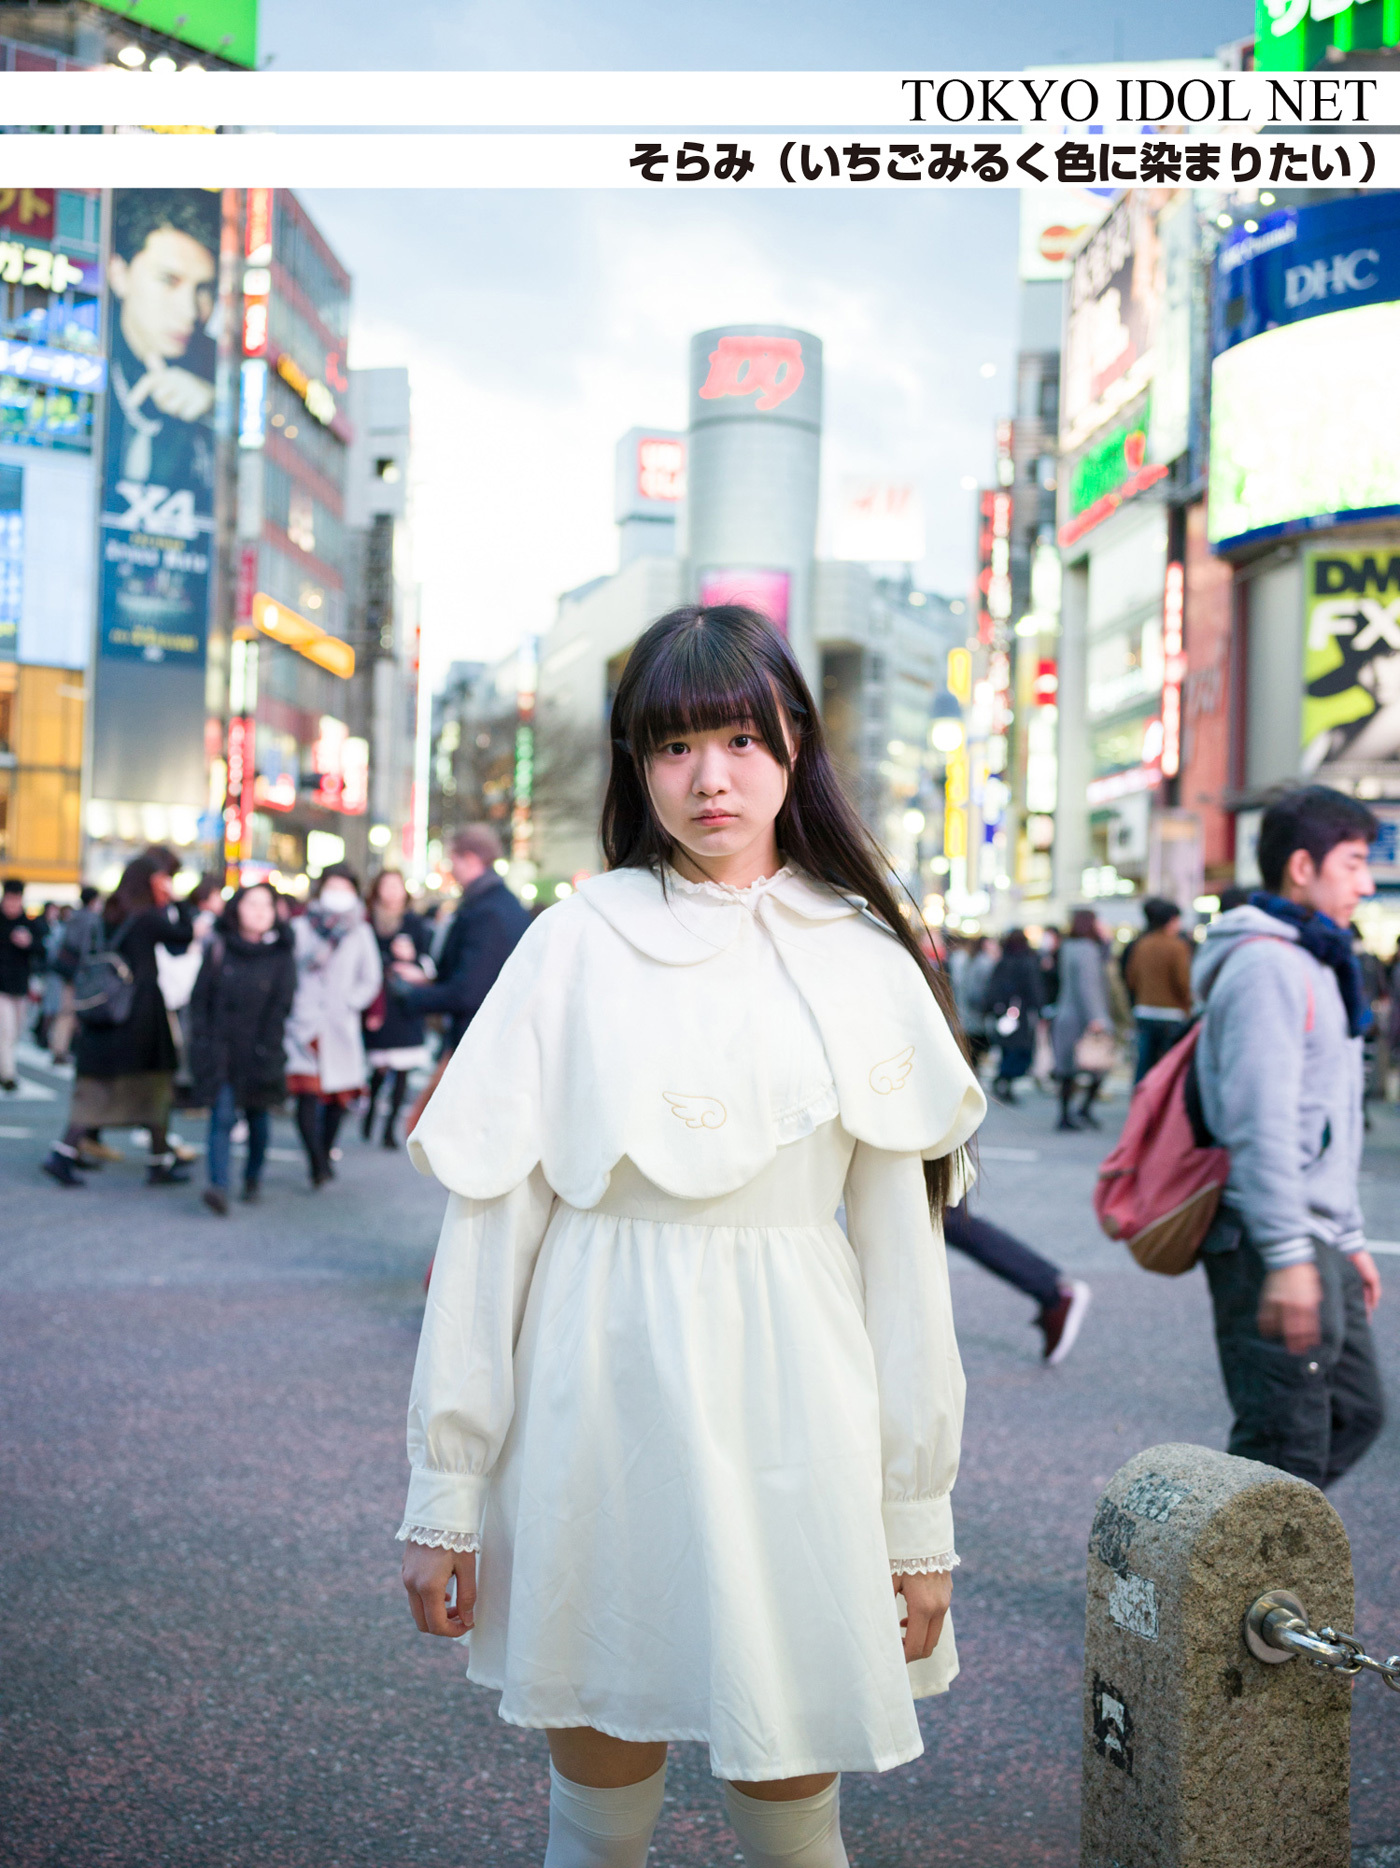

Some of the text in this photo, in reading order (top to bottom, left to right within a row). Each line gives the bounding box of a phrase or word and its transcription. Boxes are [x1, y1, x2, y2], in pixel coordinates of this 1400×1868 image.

[1285, 249, 1380, 309] DHC
[699, 335, 805, 411] 109
[1308, 598, 1400, 651] FX
